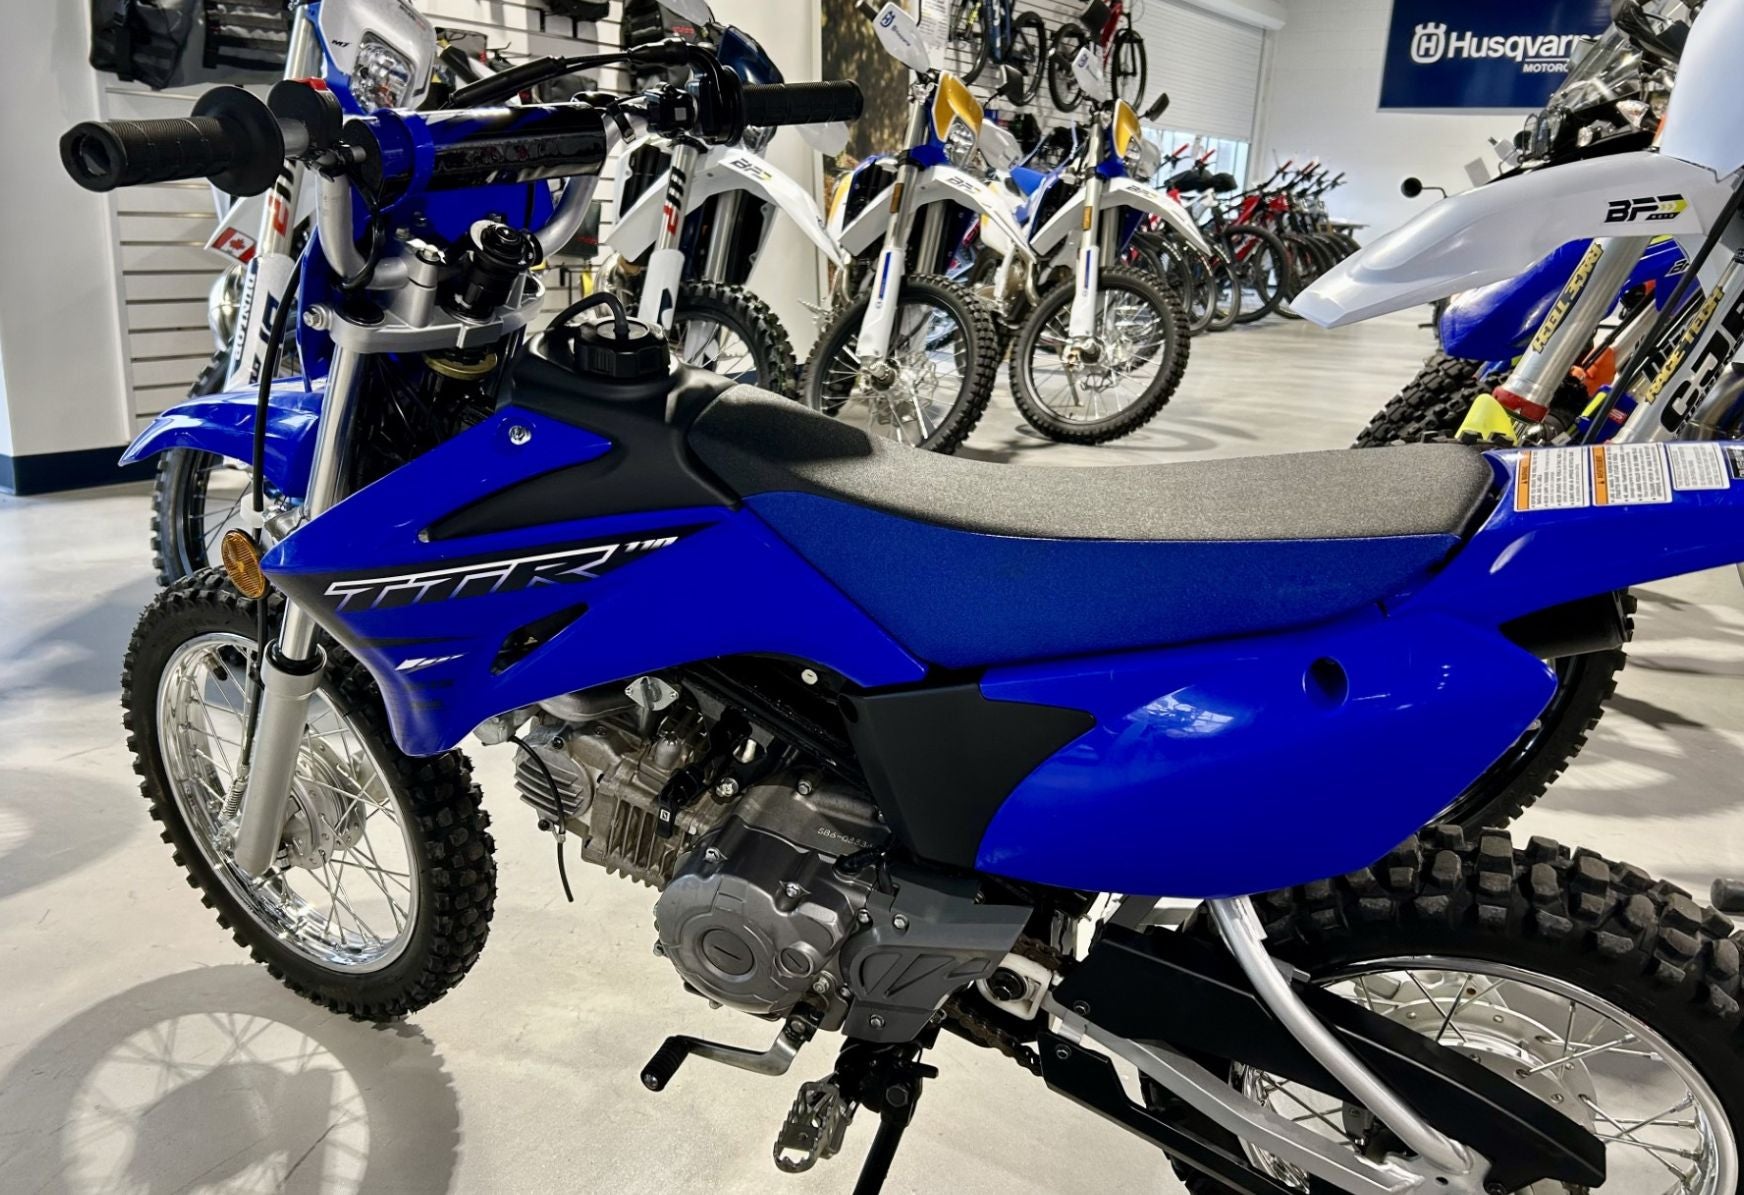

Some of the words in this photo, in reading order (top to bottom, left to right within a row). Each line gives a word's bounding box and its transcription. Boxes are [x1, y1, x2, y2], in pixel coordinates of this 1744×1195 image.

[1446, 31, 1603, 62] Husqvar
[1564, 242, 1604, 300] RACE
[235, 274, 256, 361] DUNLOP
[1532, 299, 1570, 354] TECH
[1645, 347, 1686, 405] RACE
[1682, 286, 1725, 344] TECH
